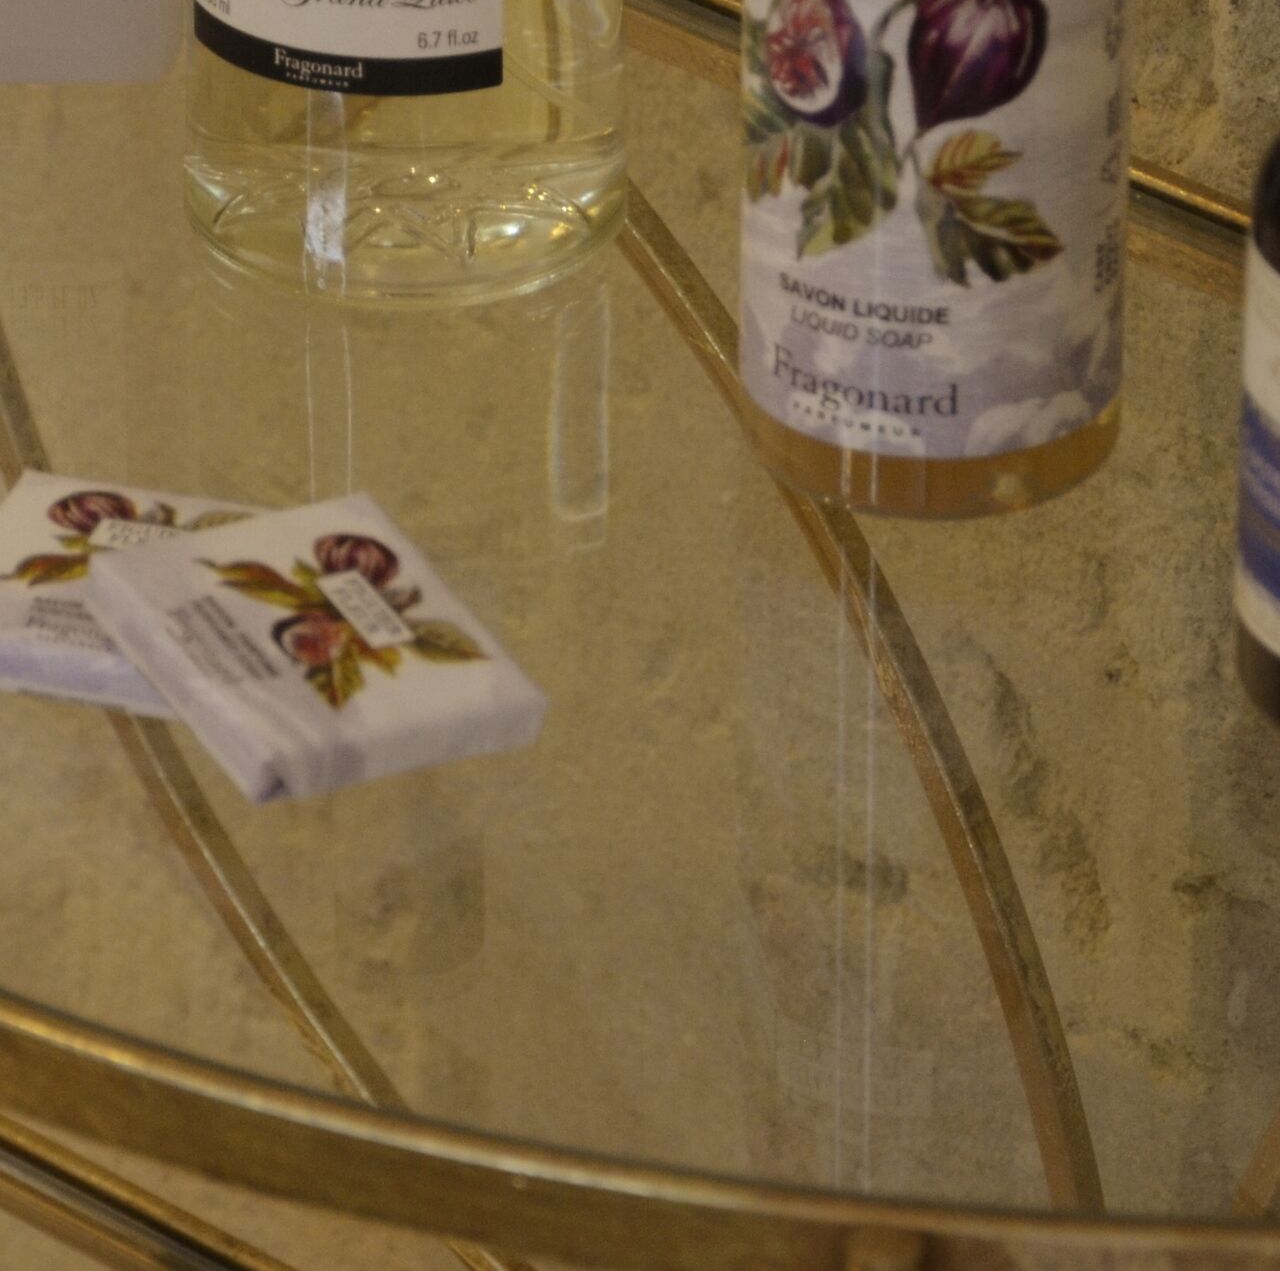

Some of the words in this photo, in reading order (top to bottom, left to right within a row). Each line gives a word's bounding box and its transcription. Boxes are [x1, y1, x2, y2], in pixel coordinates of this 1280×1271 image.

[416, 31, 442, 49] 6.7
[273, 47, 364, 79] Fragonard
[778, 272, 846, 312] SAVON
[853, 297, 951, 325] LIQUIDE
[791, 305, 858, 342] LIQUID
[867, 330, 934, 349] SOAP
[773, 343, 959, 417] Fragonard
